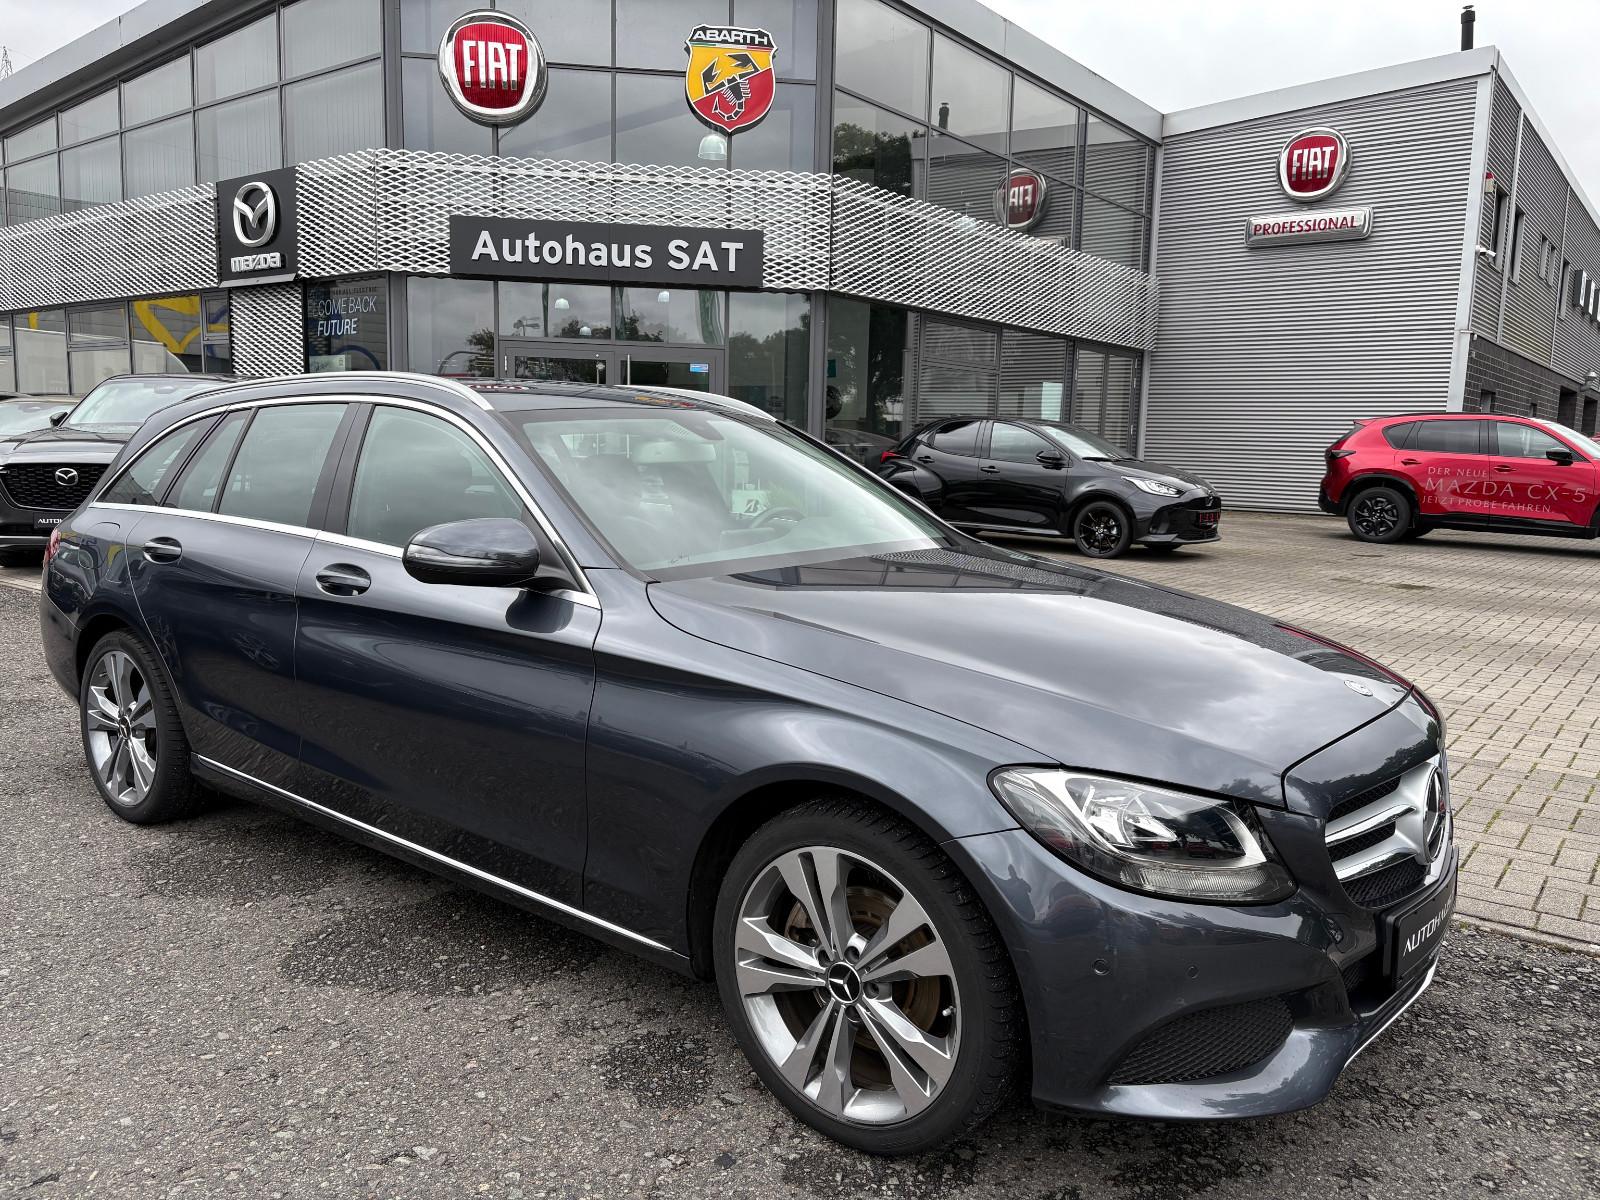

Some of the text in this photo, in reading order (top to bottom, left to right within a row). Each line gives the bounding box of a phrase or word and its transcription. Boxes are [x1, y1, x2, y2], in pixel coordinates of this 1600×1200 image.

[692, 29, 768, 45] ABARTH
[462, 40, 523, 91] FIAT
[1292, 146, 1334, 181] FIAT
[1253, 215, 1357, 236] PROFESSIONAL
[471, 230, 744, 272] Autohaus SAT
[348, 296, 377, 313] BACK
[317, 317, 358, 337] FUTURE
[1428, 466, 1487, 478] DER NEUE
[1425, 477, 1586, 503] MAZDA CX-5
[1422, 495, 1454, 505] JETZT
[1458, 498, 1497, 509] PROBE
